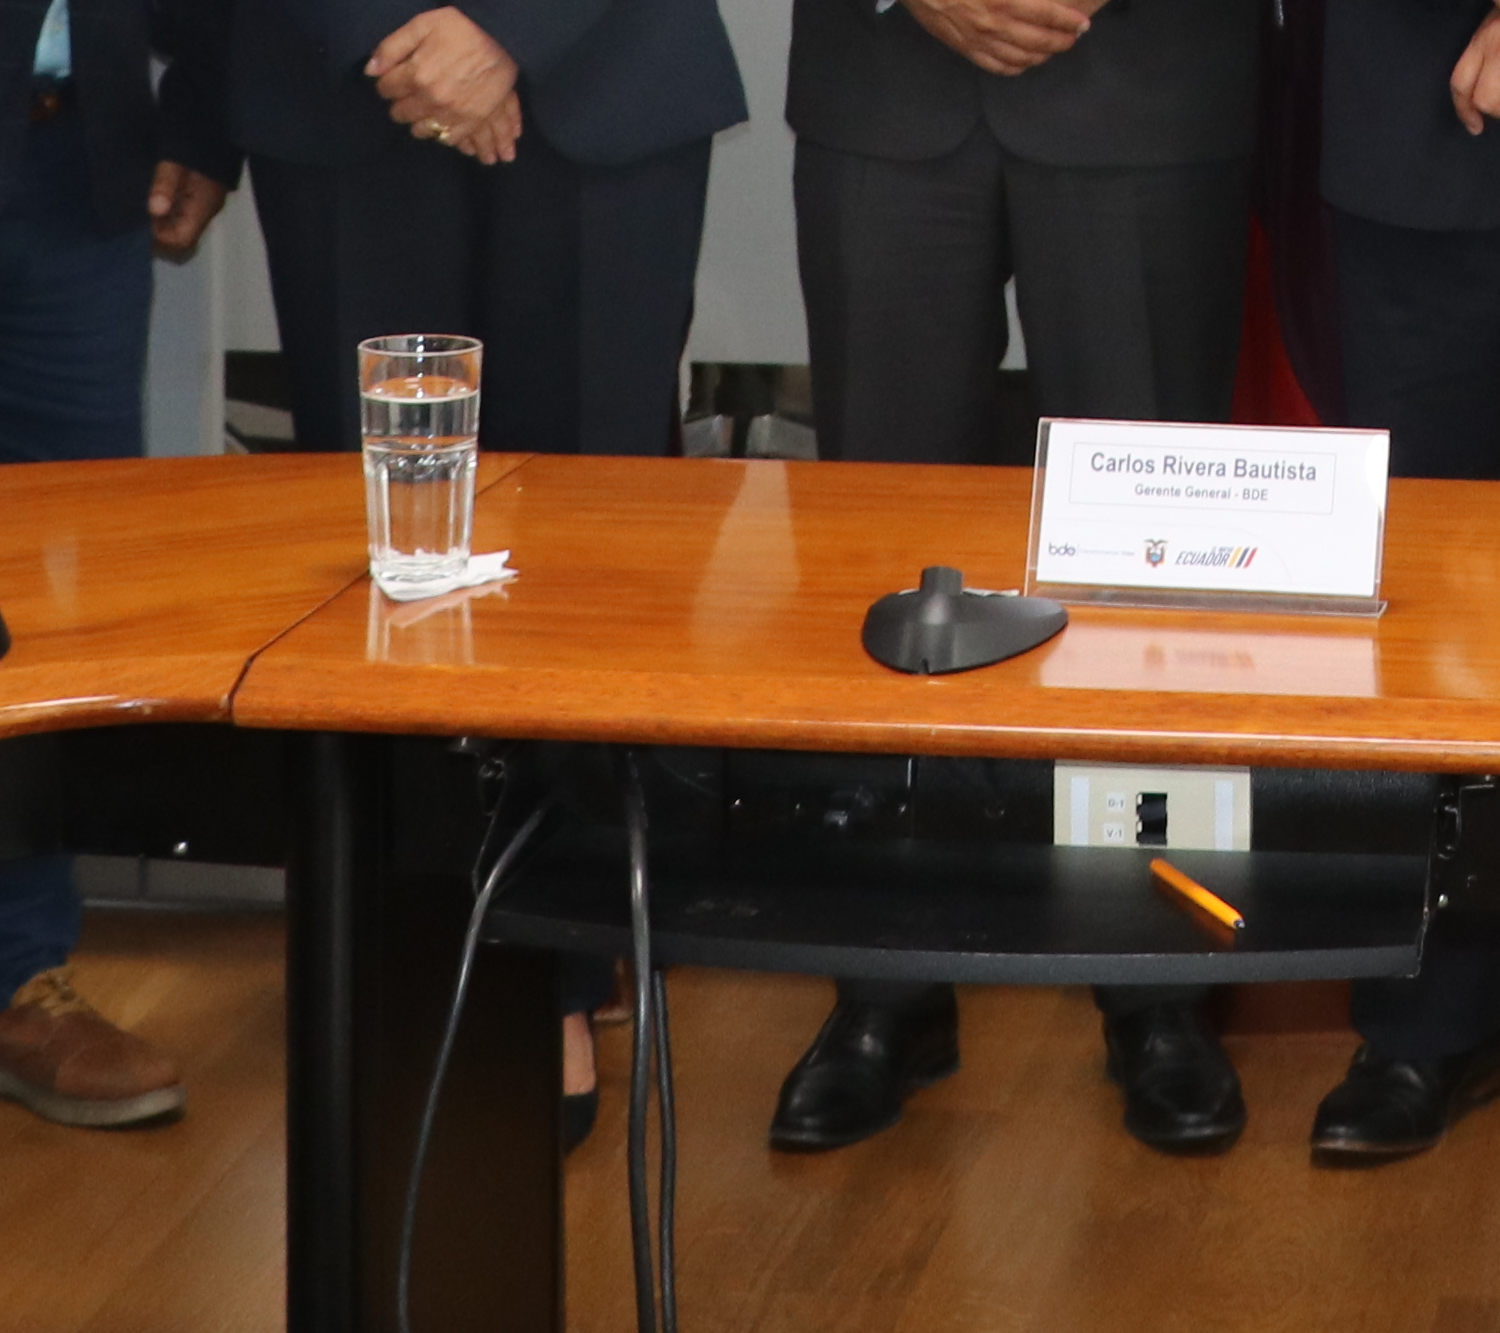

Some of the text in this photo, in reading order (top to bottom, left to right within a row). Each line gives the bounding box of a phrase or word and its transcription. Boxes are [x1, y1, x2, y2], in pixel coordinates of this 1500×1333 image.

[1090, 452, 1317, 481] Carlos Rivera Bautista
[1134, 484, 1181, 499] Gerente
[1185, 485, 1231, 500] General
[1242, 488, 1268, 502] BDE
[1175, 550, 1230, 567] ECUADOR
